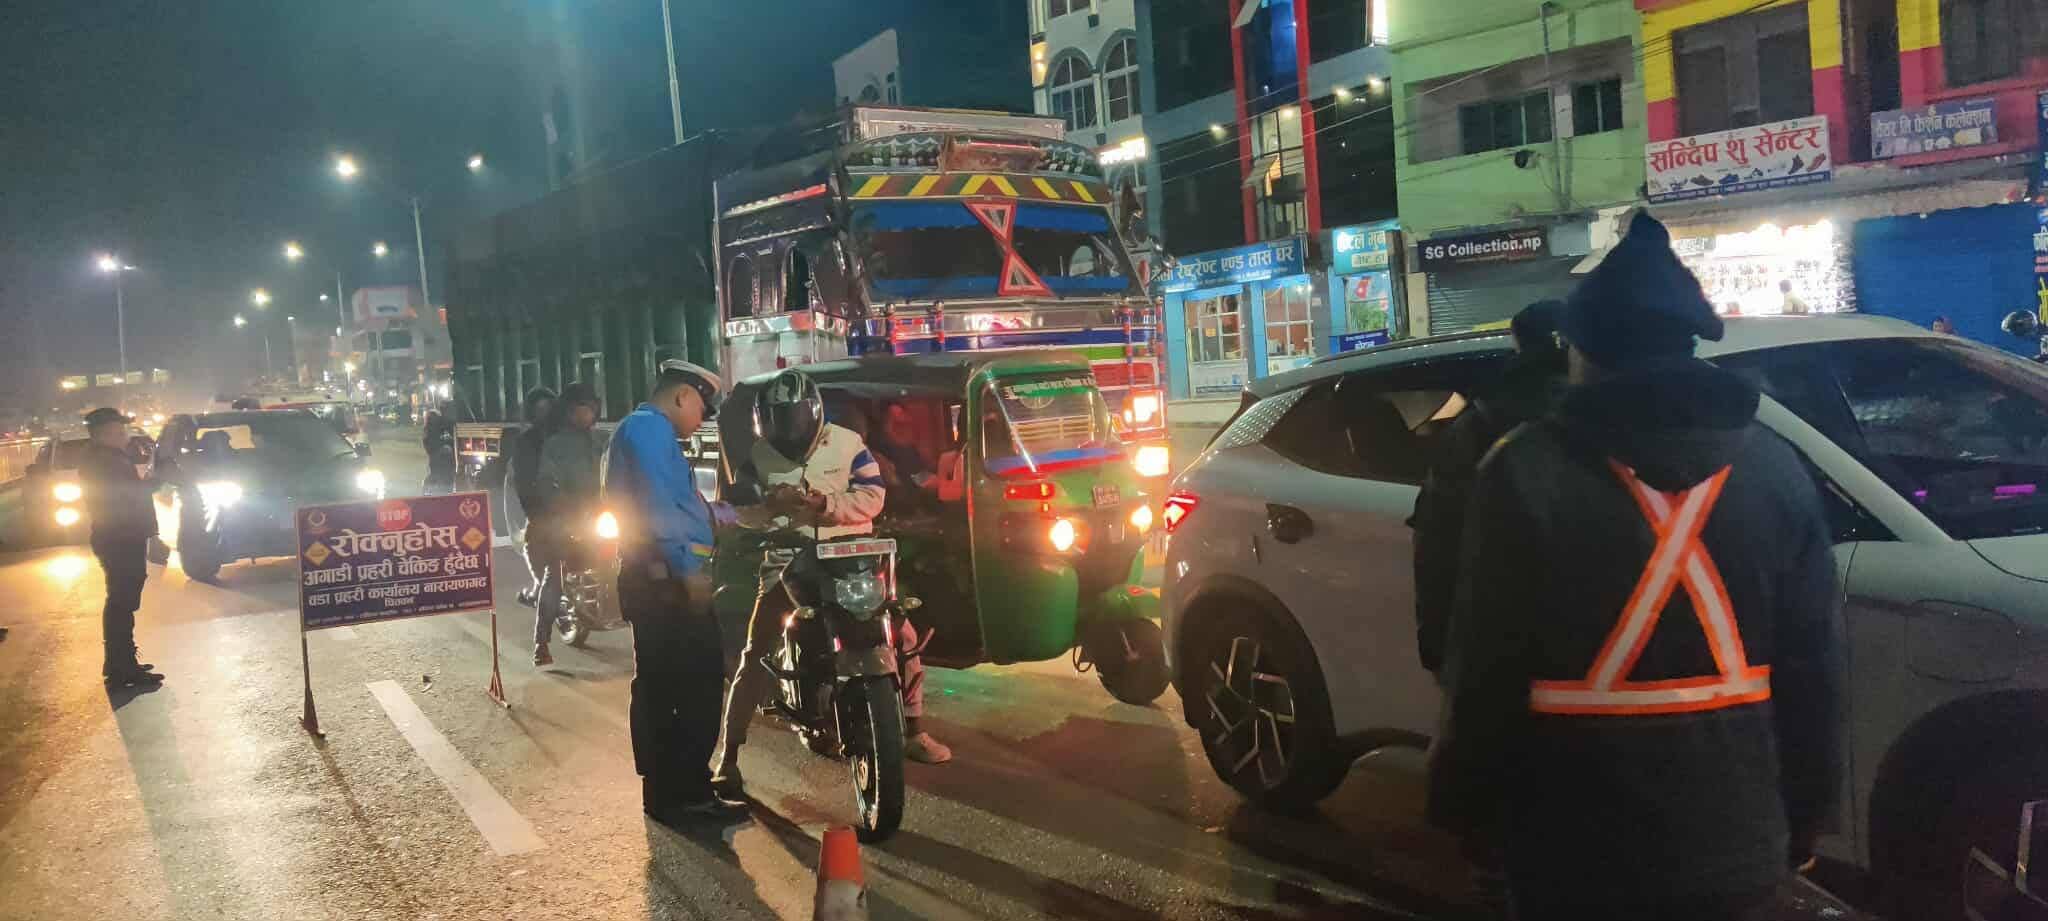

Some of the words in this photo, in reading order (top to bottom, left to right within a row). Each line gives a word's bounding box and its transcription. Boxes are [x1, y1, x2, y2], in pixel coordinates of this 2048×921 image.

[1726, 138, 1749, 165] शु
[1753, 126, 1822, 157] सेन्टर
[1425, 246, 1444, 259] SG
[1448, 236, 1542, 257] Collection.np
[358, 558, 393, 582] प्रहरी
[334, 586, 365, 606] प्रहरी
[368, 582, 420, 600] कार्यालय
